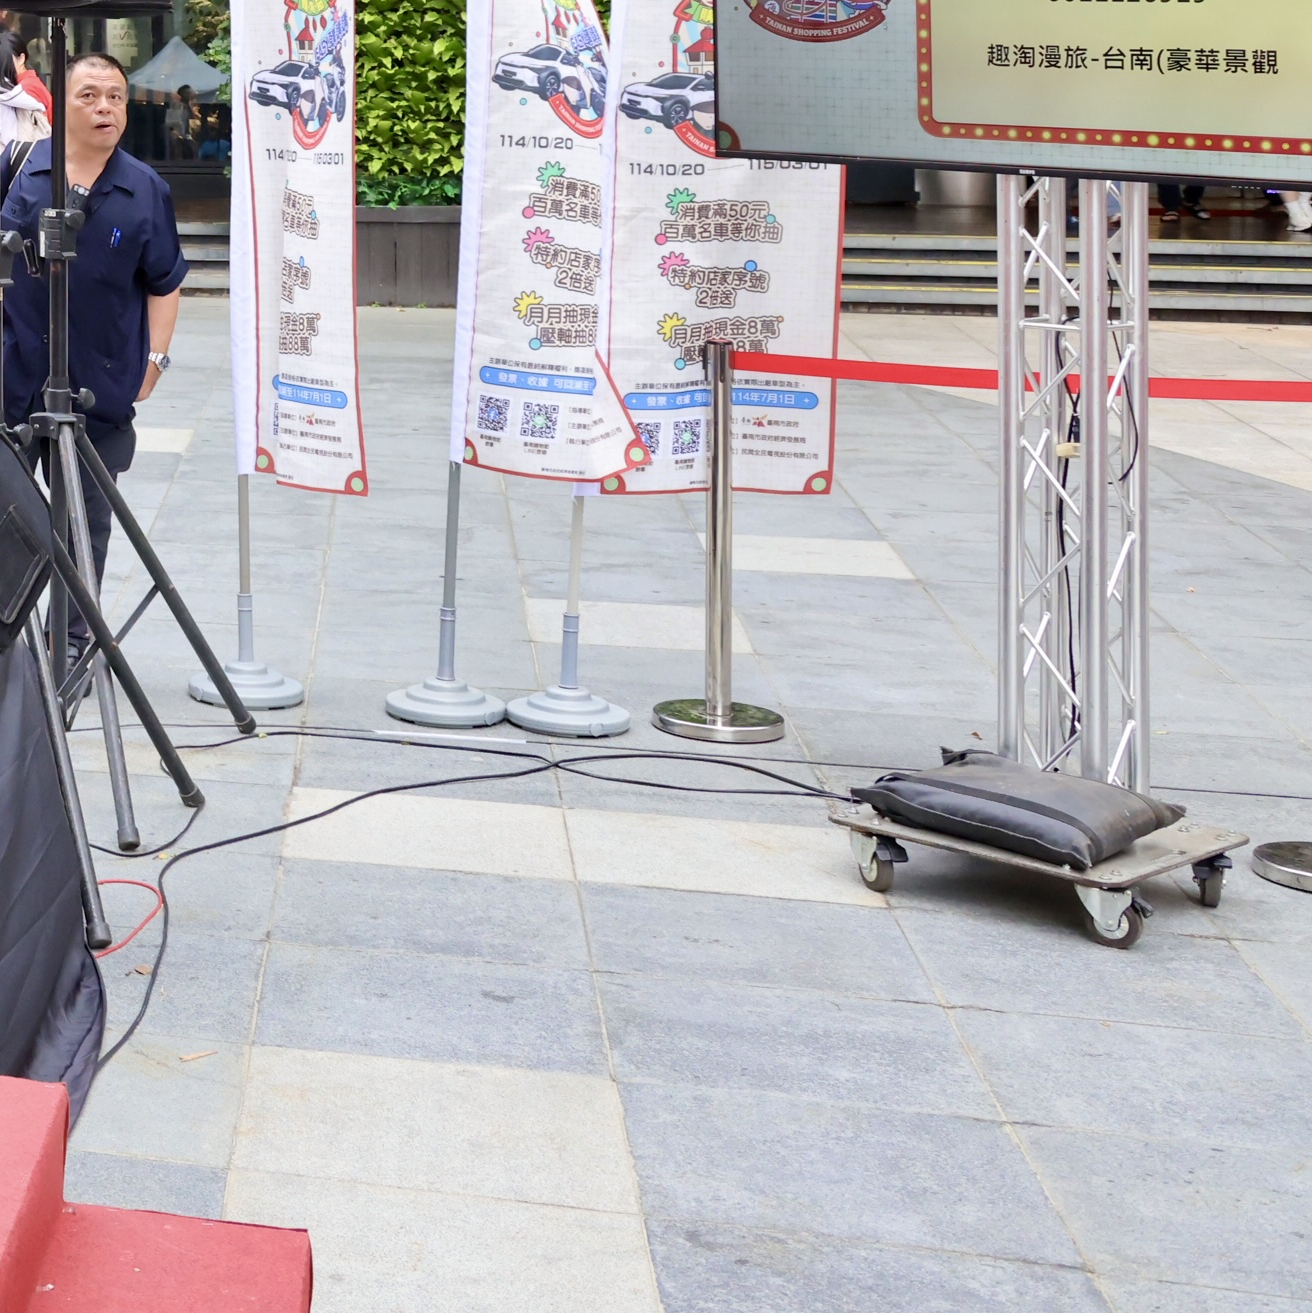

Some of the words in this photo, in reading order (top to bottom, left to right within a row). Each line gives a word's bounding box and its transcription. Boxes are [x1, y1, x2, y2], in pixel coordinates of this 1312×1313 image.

[766, 17, 792, 34] TAINAN
[793, 27, 832, 37] SHOPPING
[833, 19, 869, 35] FESTIVAL
[987, 44, 1279, 75] 趣淘漫旅-台南(豪華景觀
[500, 134, 574, 150] 114/10/20
[629, 162, 706, 177] 114/10/20
[678, 202, 768, 221] 消費滿50元
[663, 222, 780, 240] 百萬名車等你抽
[670, 267, 766, 289] 特約店家序號
[698, 289, 735, 306] 2倍送
